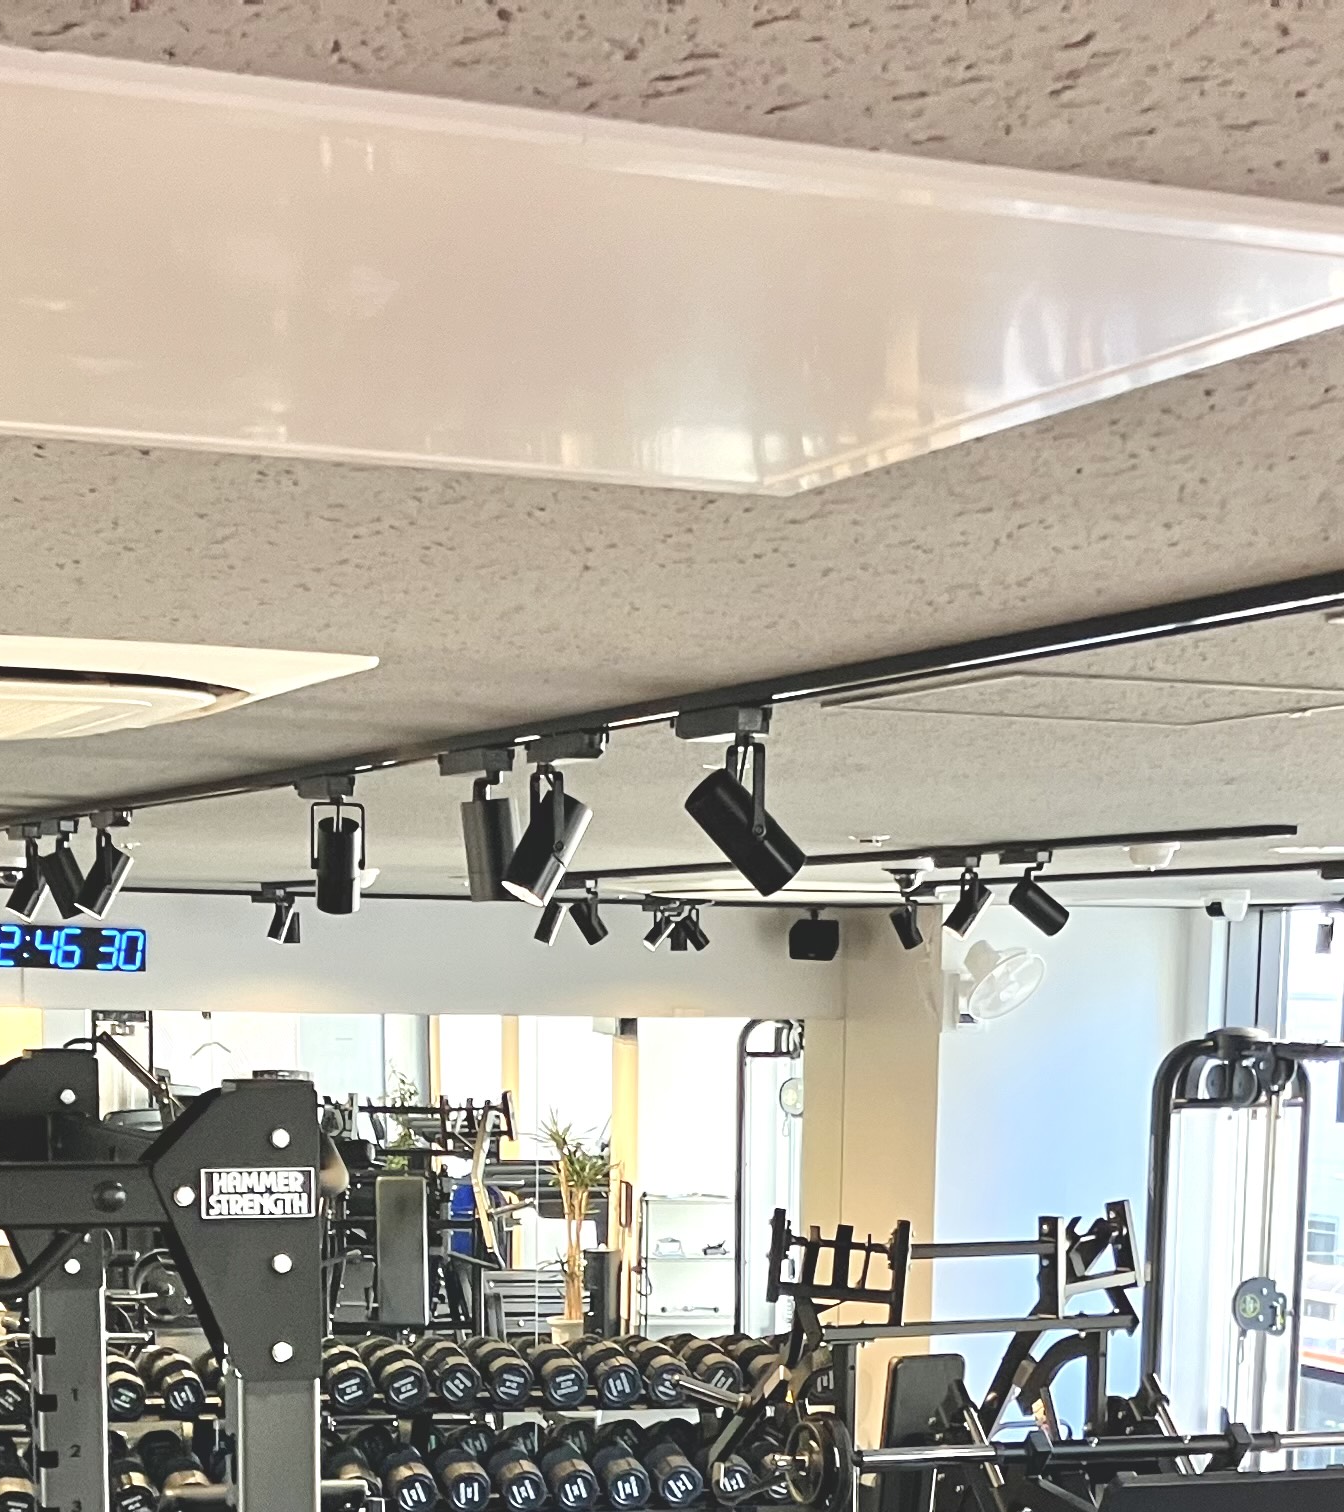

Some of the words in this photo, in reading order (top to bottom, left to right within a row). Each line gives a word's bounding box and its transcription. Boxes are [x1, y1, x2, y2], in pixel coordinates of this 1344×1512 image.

[96, 929, 145, 971] 30
[212, 1171, 305, 1195] HAMMER
[208, 1192, 308, 1216] STRENGTH
[70, 1444, 81, 1458] 2
